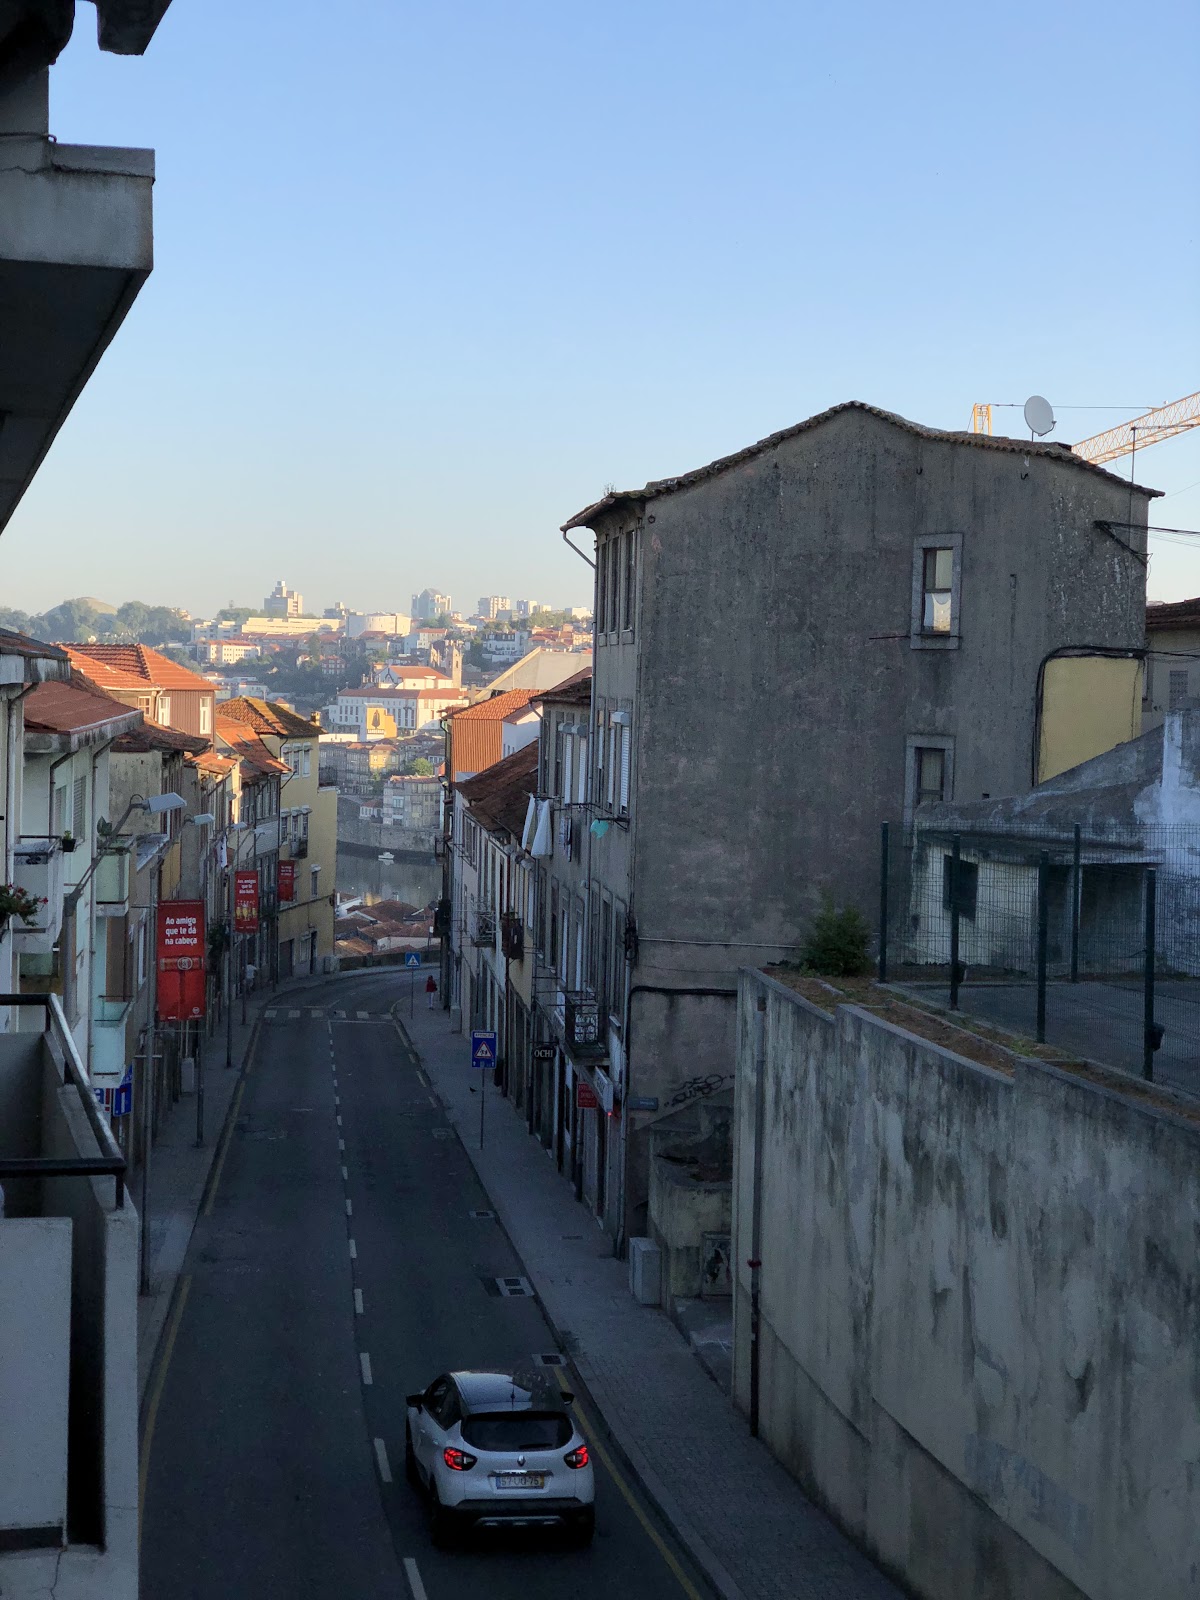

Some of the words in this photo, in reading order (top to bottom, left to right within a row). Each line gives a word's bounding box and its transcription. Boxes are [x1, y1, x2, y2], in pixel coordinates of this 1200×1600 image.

[165, 917, 174, 925] Ao
[175, 917, 197, 926] amigo
[165, 928, 178, 937] que
[179, 927, 187, 935] te
[188, 926, 197, 934] dá
[174, 937, 197, 946] cabeça
[534, 1049, 554, 1058] OCHI
